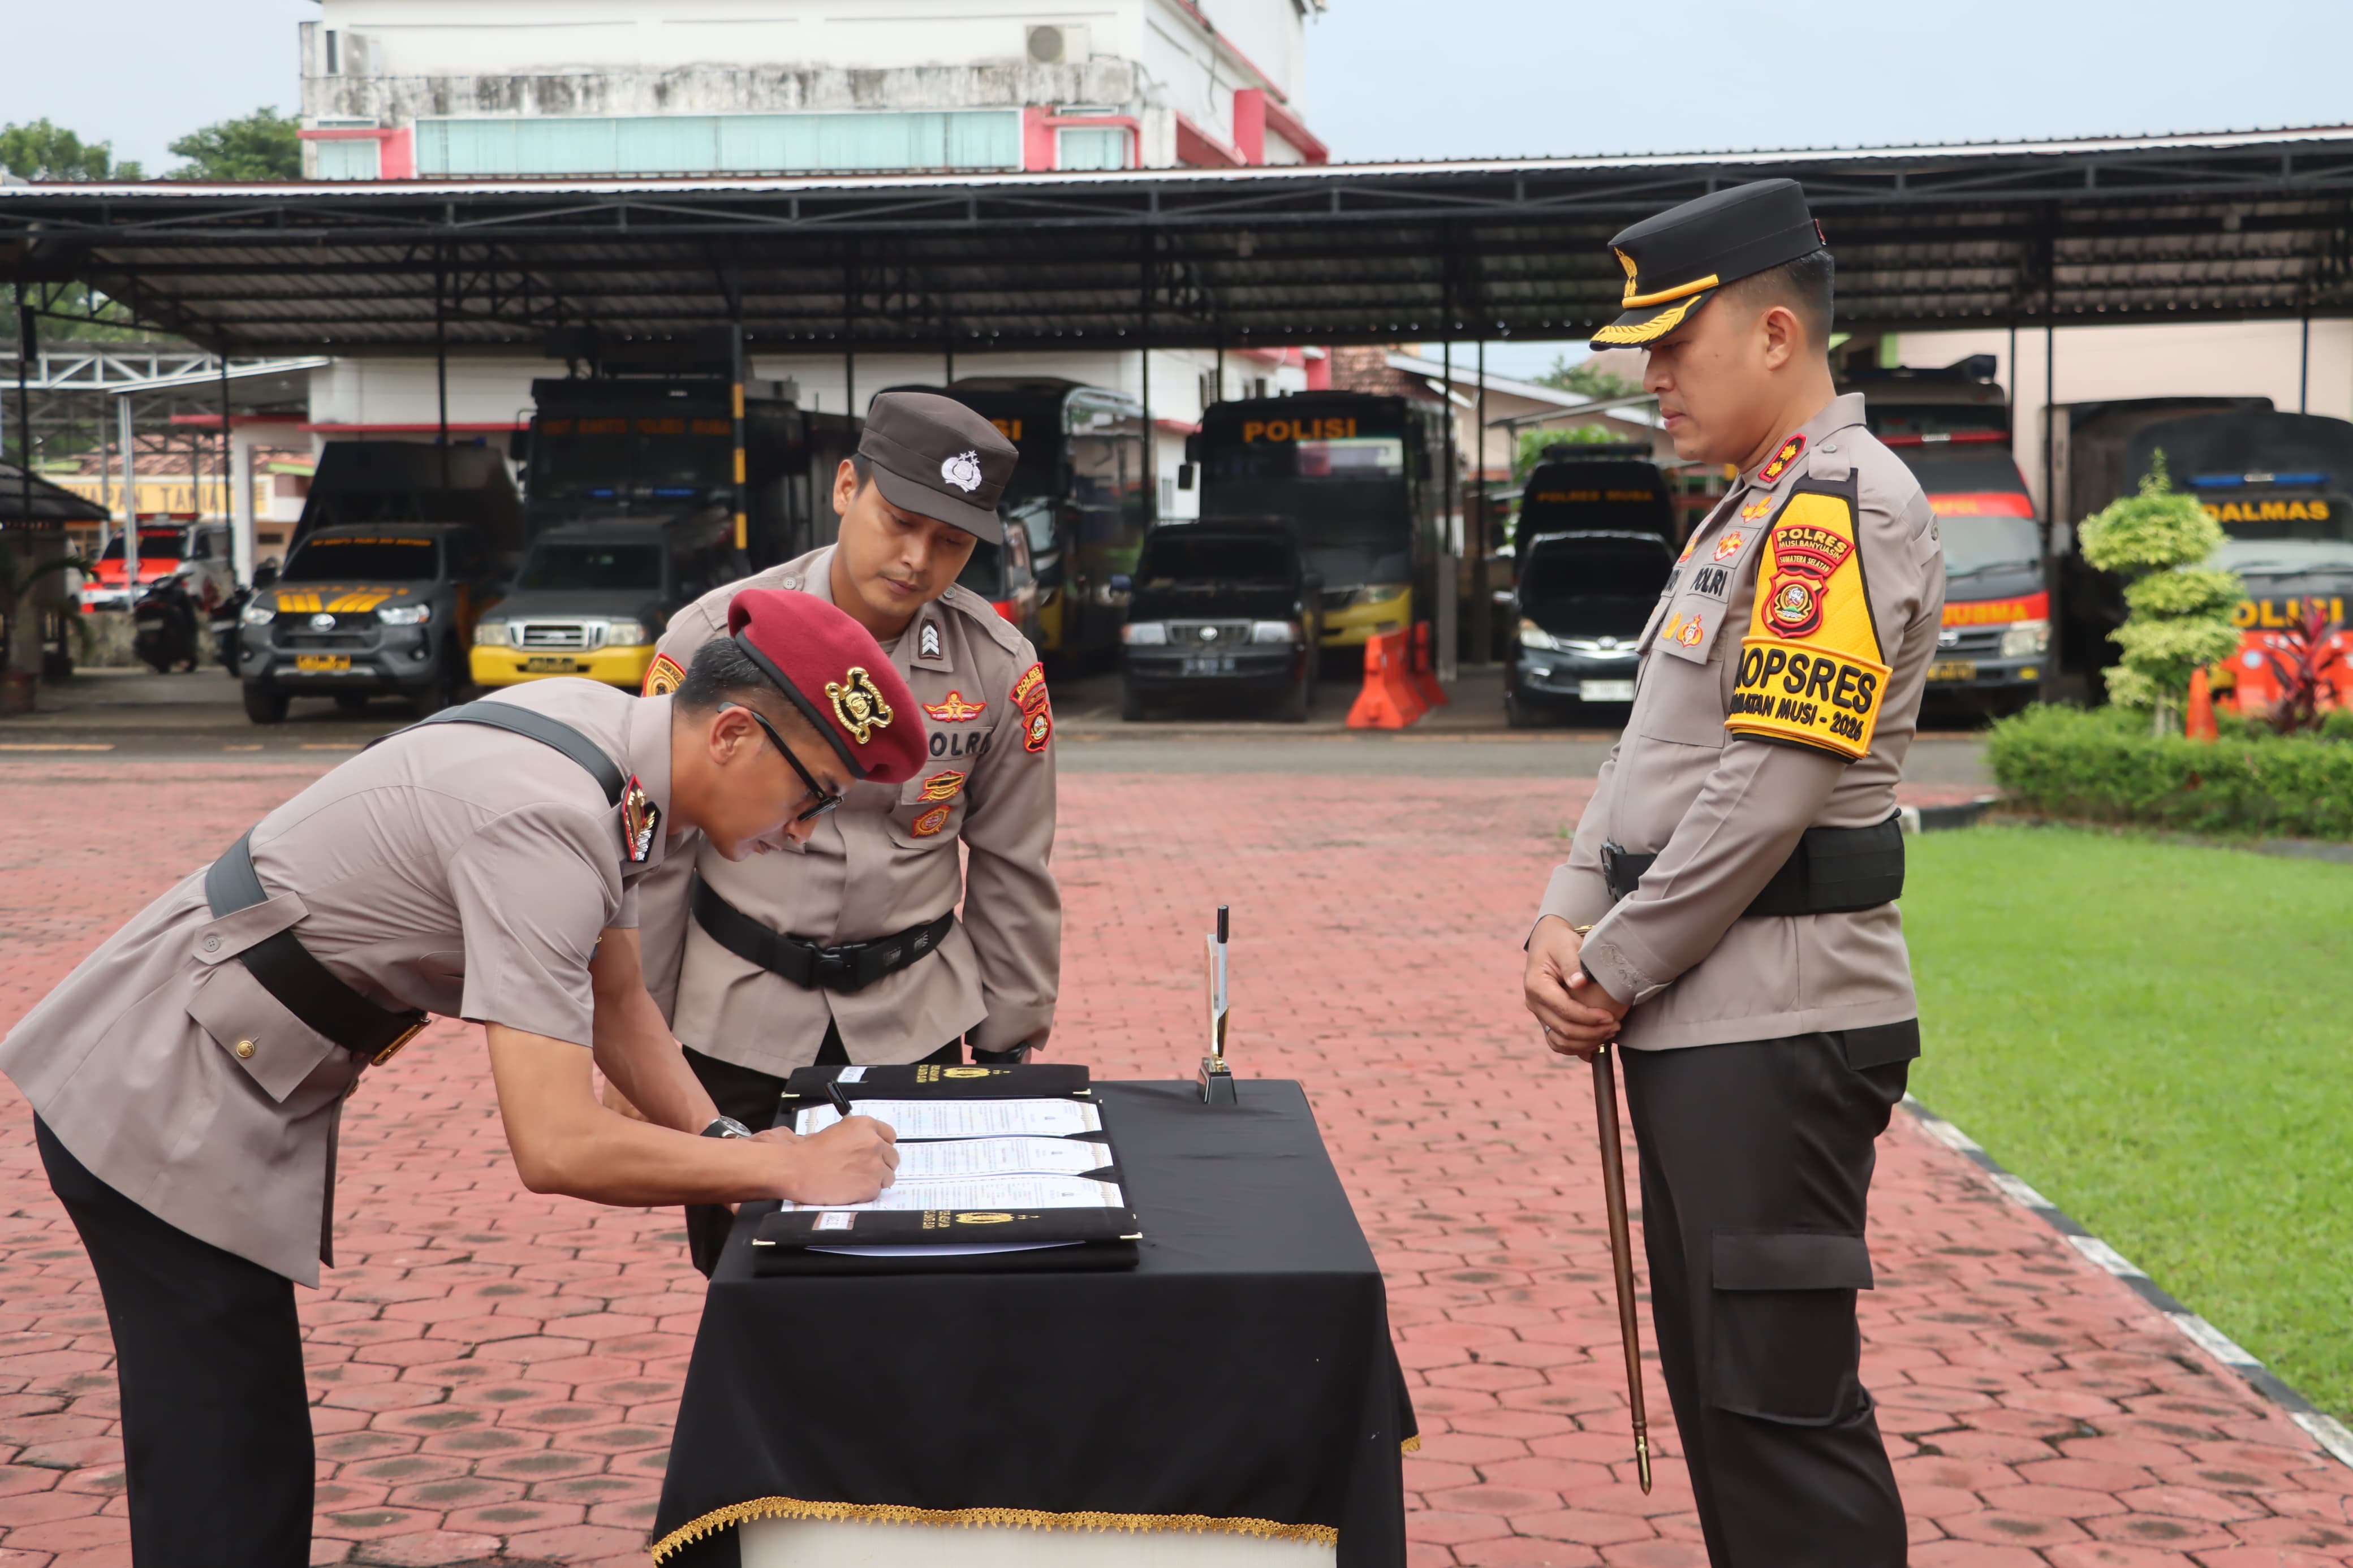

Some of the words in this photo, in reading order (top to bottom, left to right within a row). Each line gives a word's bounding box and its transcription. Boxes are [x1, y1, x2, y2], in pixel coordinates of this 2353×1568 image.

[1244, 418, 1356, 442] POLISI
[2202, 501, 2329, 522] DALMAS
[1777, 528, 1847, 553] POLRES
[1799, 541, 1842, 560] BANYUASIN
[1779, 555, 1806, 564] SUMATERA
[1807, 558, 1830, 572] SELATAN
[2231, 598, 2343, 628] OLII
[1016, 666, 1040, 696] POLRES
[1775, 698, 1817, 726] MUSI
[929, 732, 992, 757] OLRI
